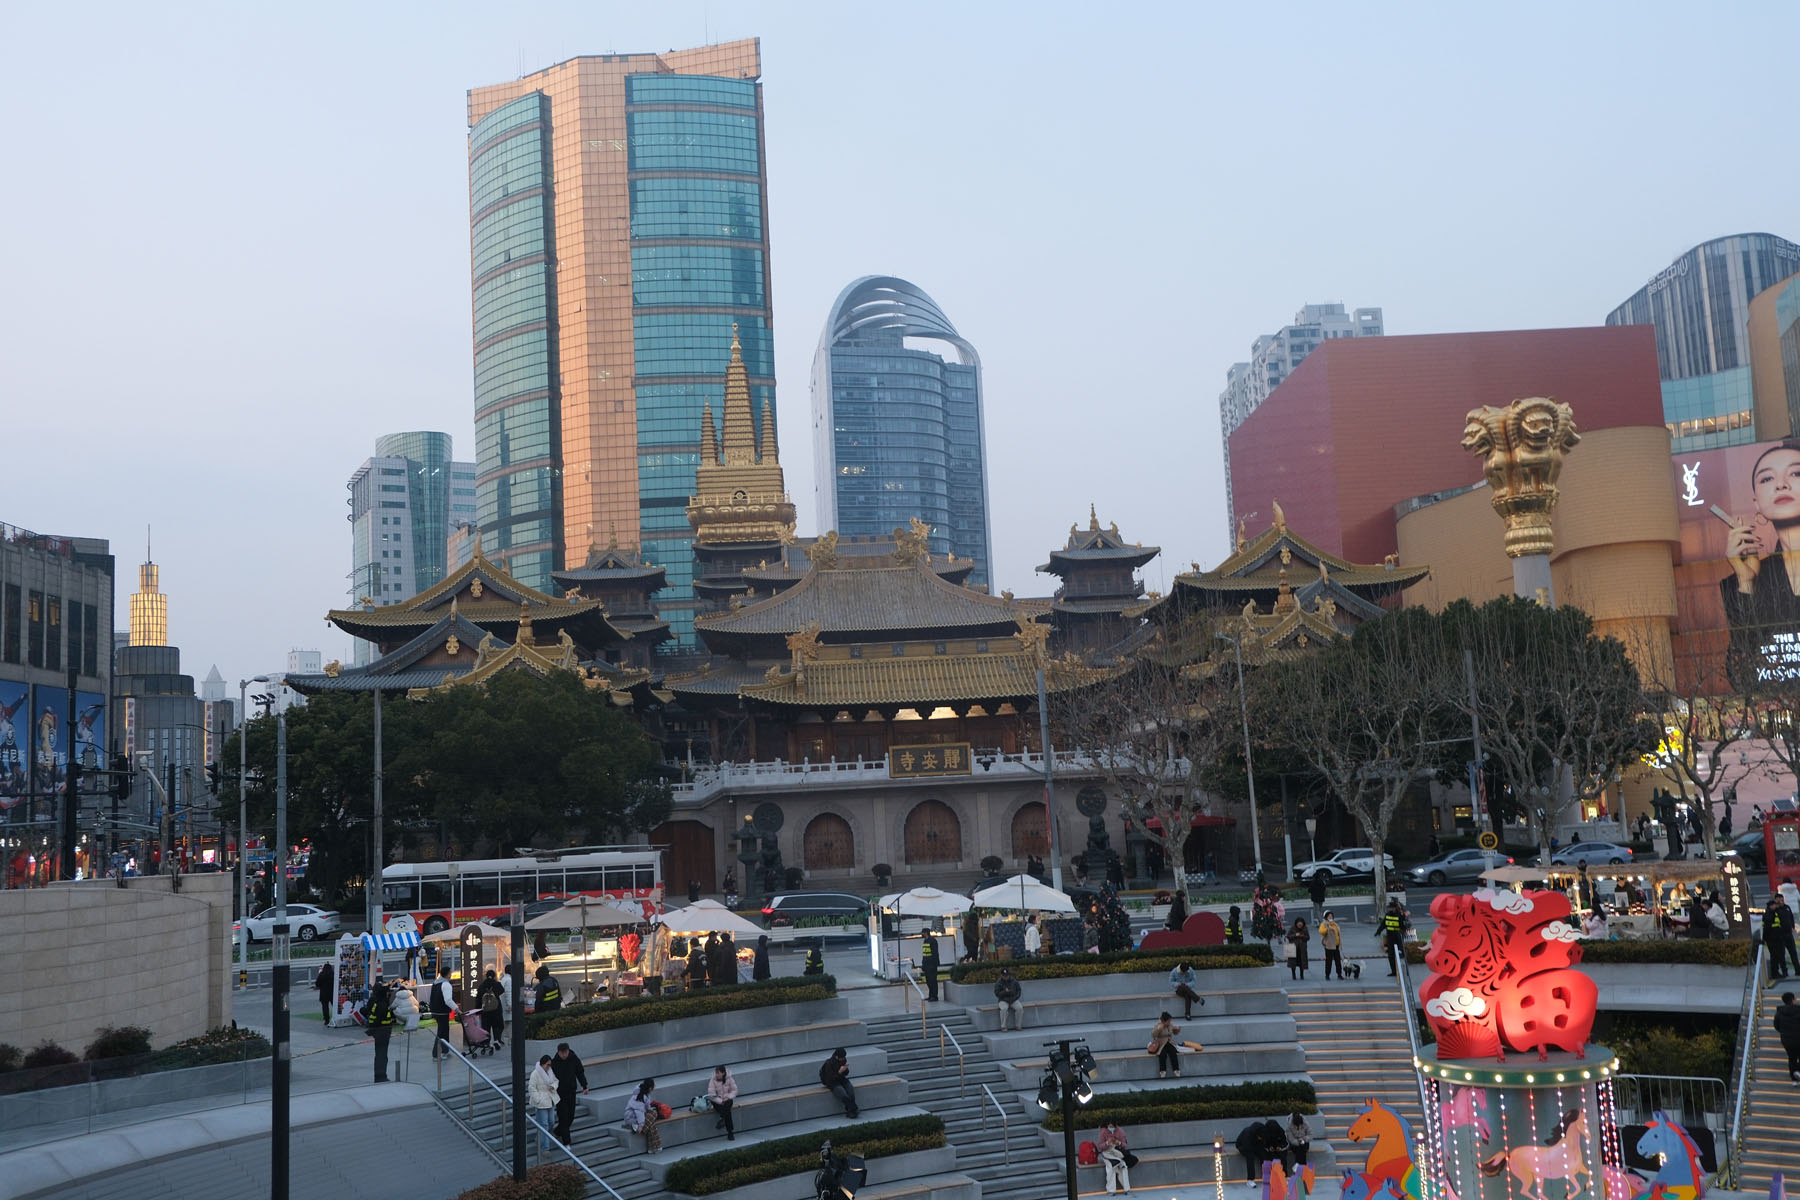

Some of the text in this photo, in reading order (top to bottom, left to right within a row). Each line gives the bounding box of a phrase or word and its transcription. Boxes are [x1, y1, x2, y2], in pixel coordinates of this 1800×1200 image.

[1682, 461, 1704, 506] YSL
[469, 949, 479, 998] 静安寺广场
